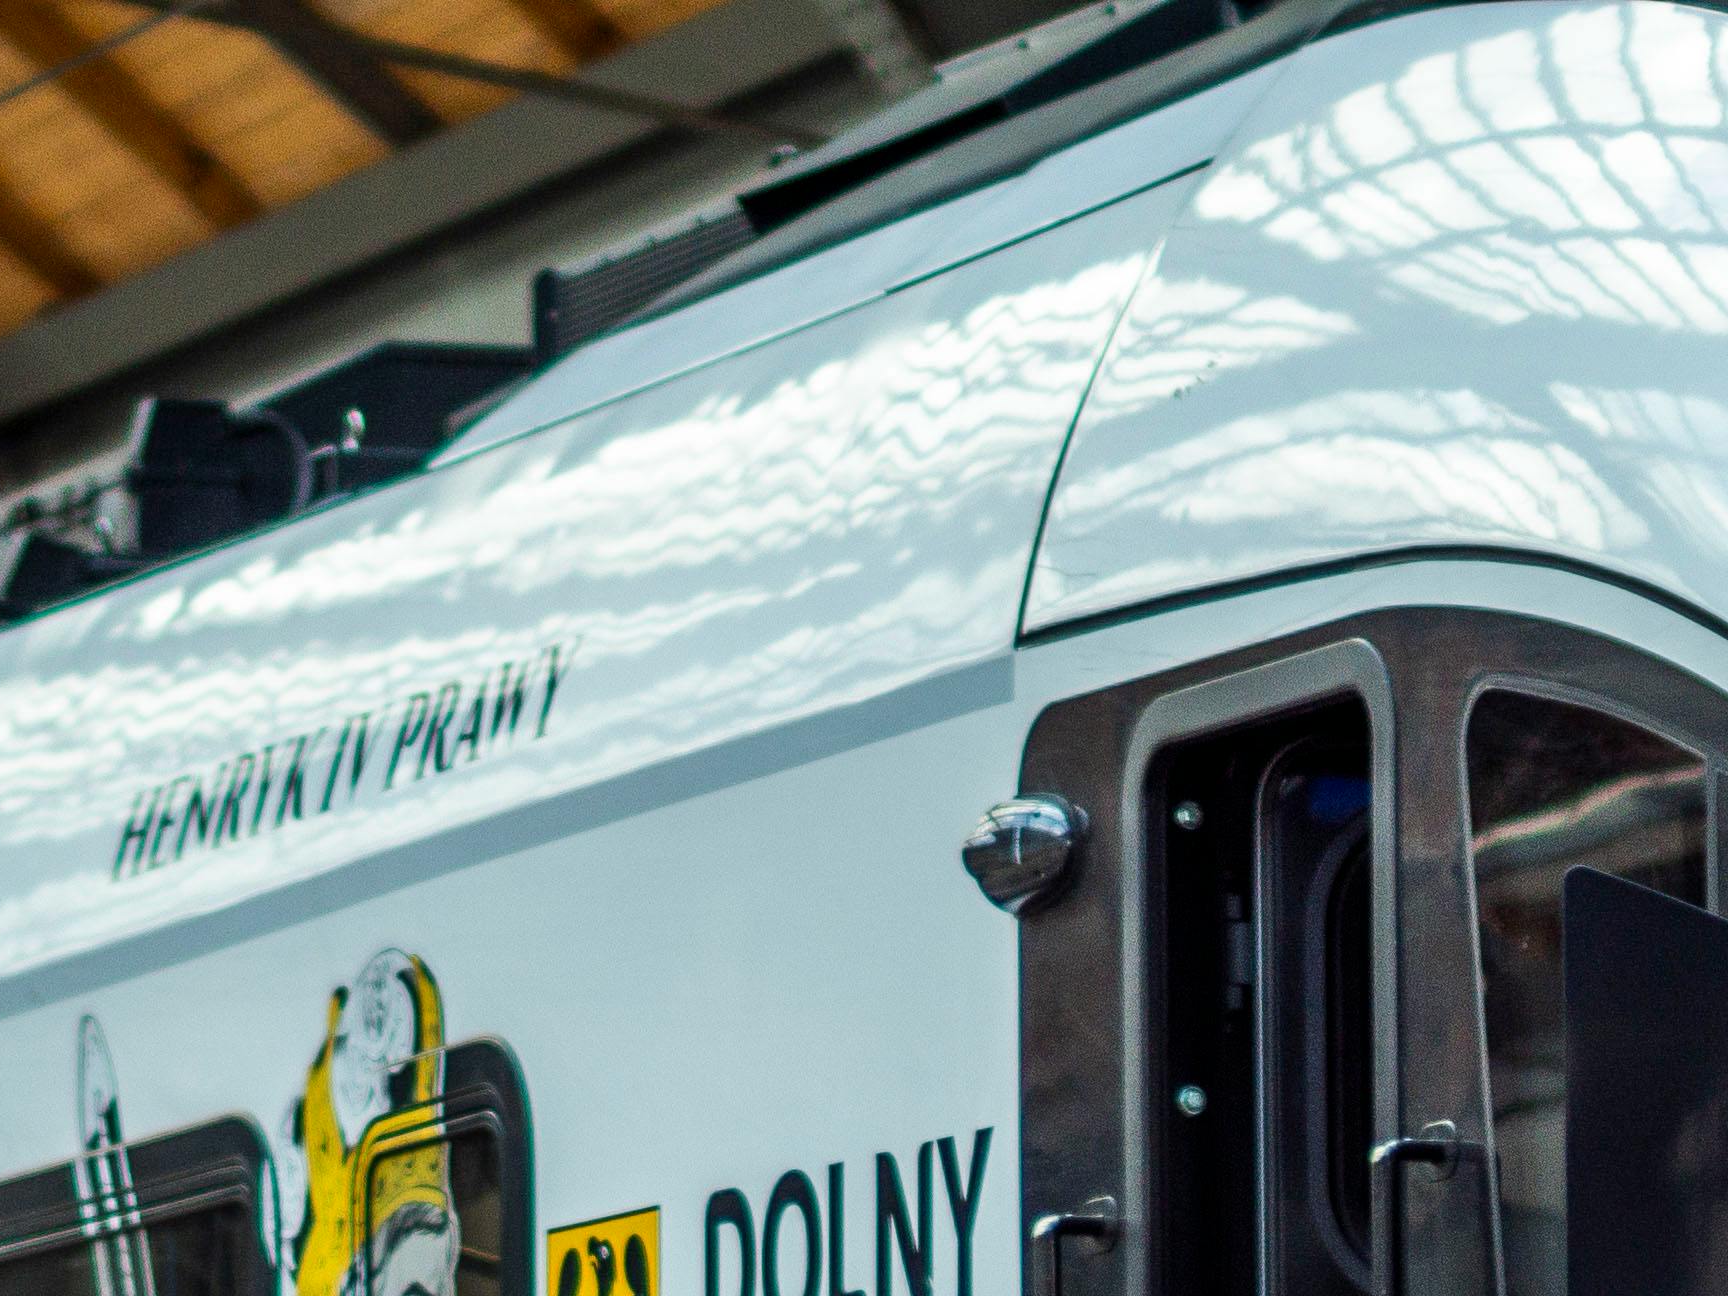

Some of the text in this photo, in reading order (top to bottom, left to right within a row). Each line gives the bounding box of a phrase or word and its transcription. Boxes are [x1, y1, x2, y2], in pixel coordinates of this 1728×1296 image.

[109, 636, 581, 883] HENRYK IV PRAWY
